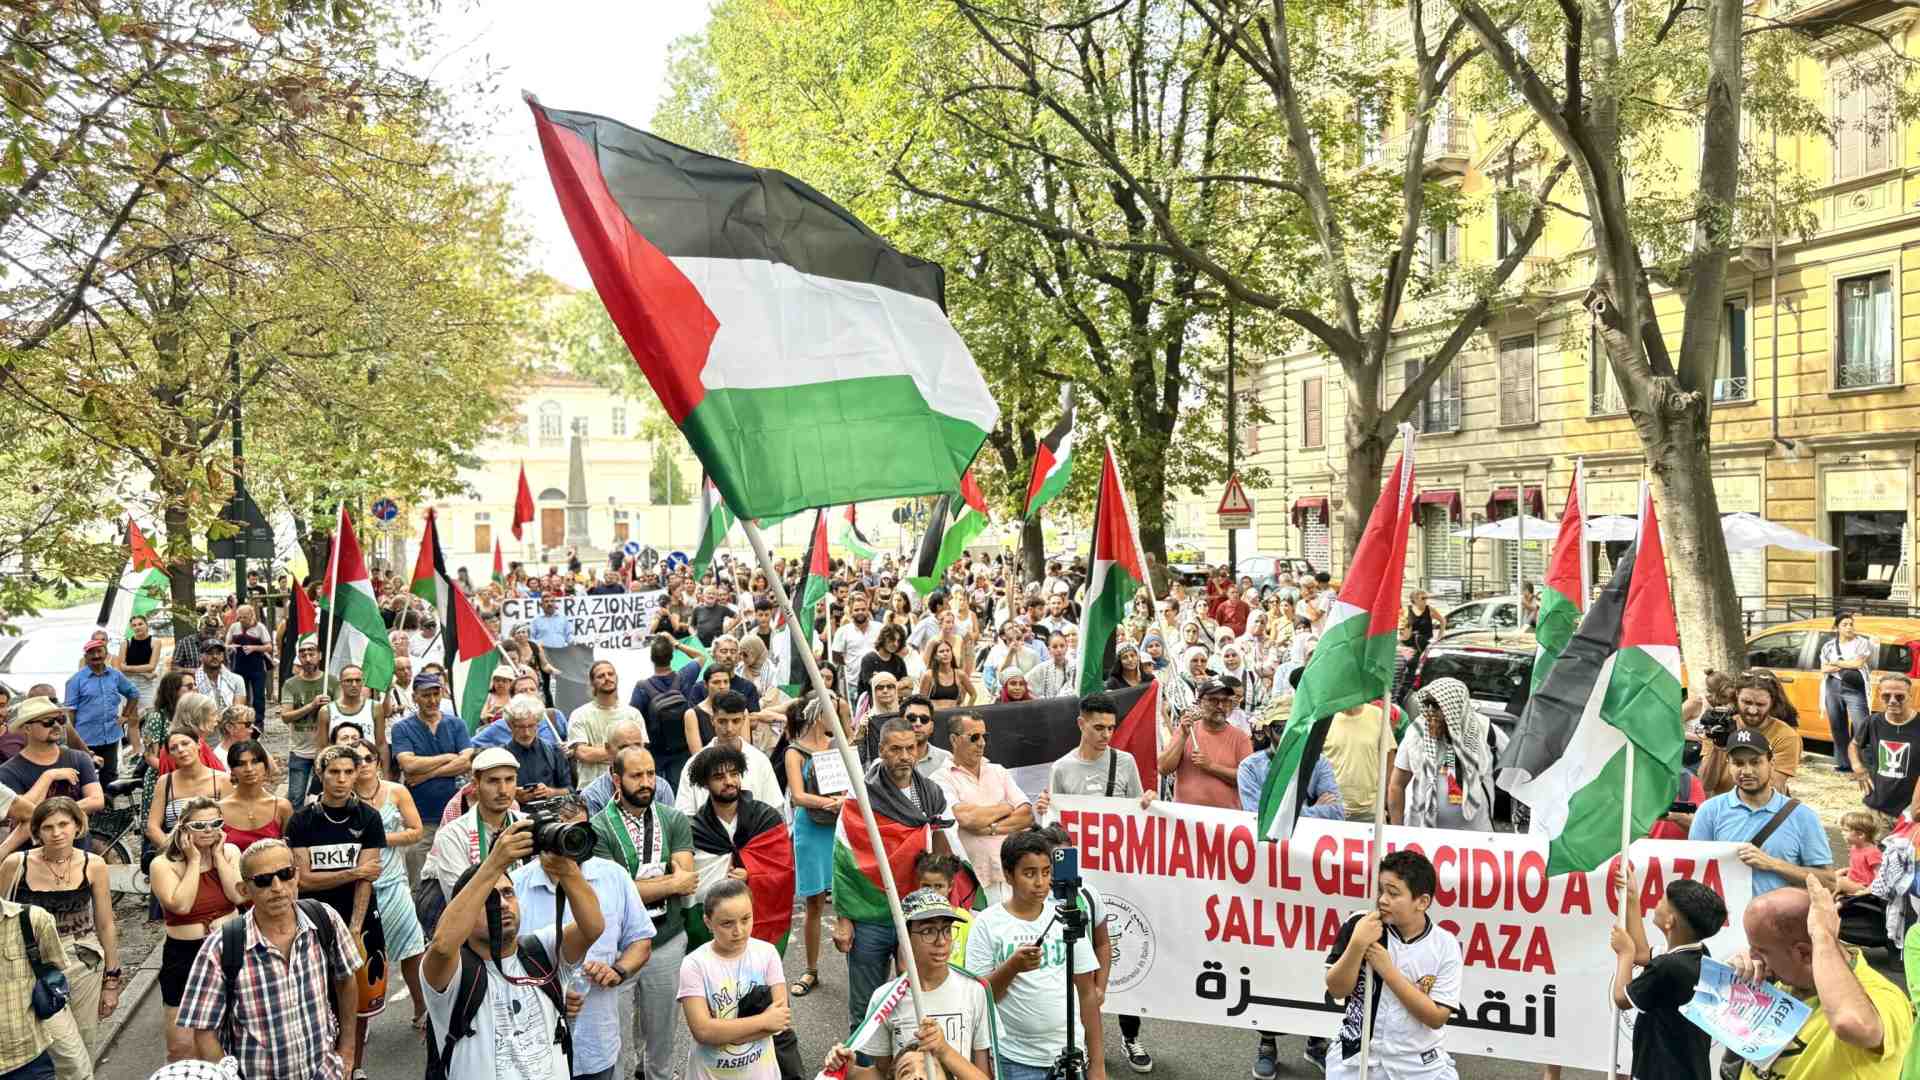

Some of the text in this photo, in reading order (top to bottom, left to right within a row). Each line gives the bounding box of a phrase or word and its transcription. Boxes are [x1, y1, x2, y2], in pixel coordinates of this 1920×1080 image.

[503, 596, 644, 619] GERAZIONE
[567, 612, 646, 635] RAZIONE
[1268, 839, 1302, 892] IL
[1560, 871, 1592, 916] A
[1205, 893, 1344, 952] SALVIA
[716, 1049, 763, 1069] FASHION
